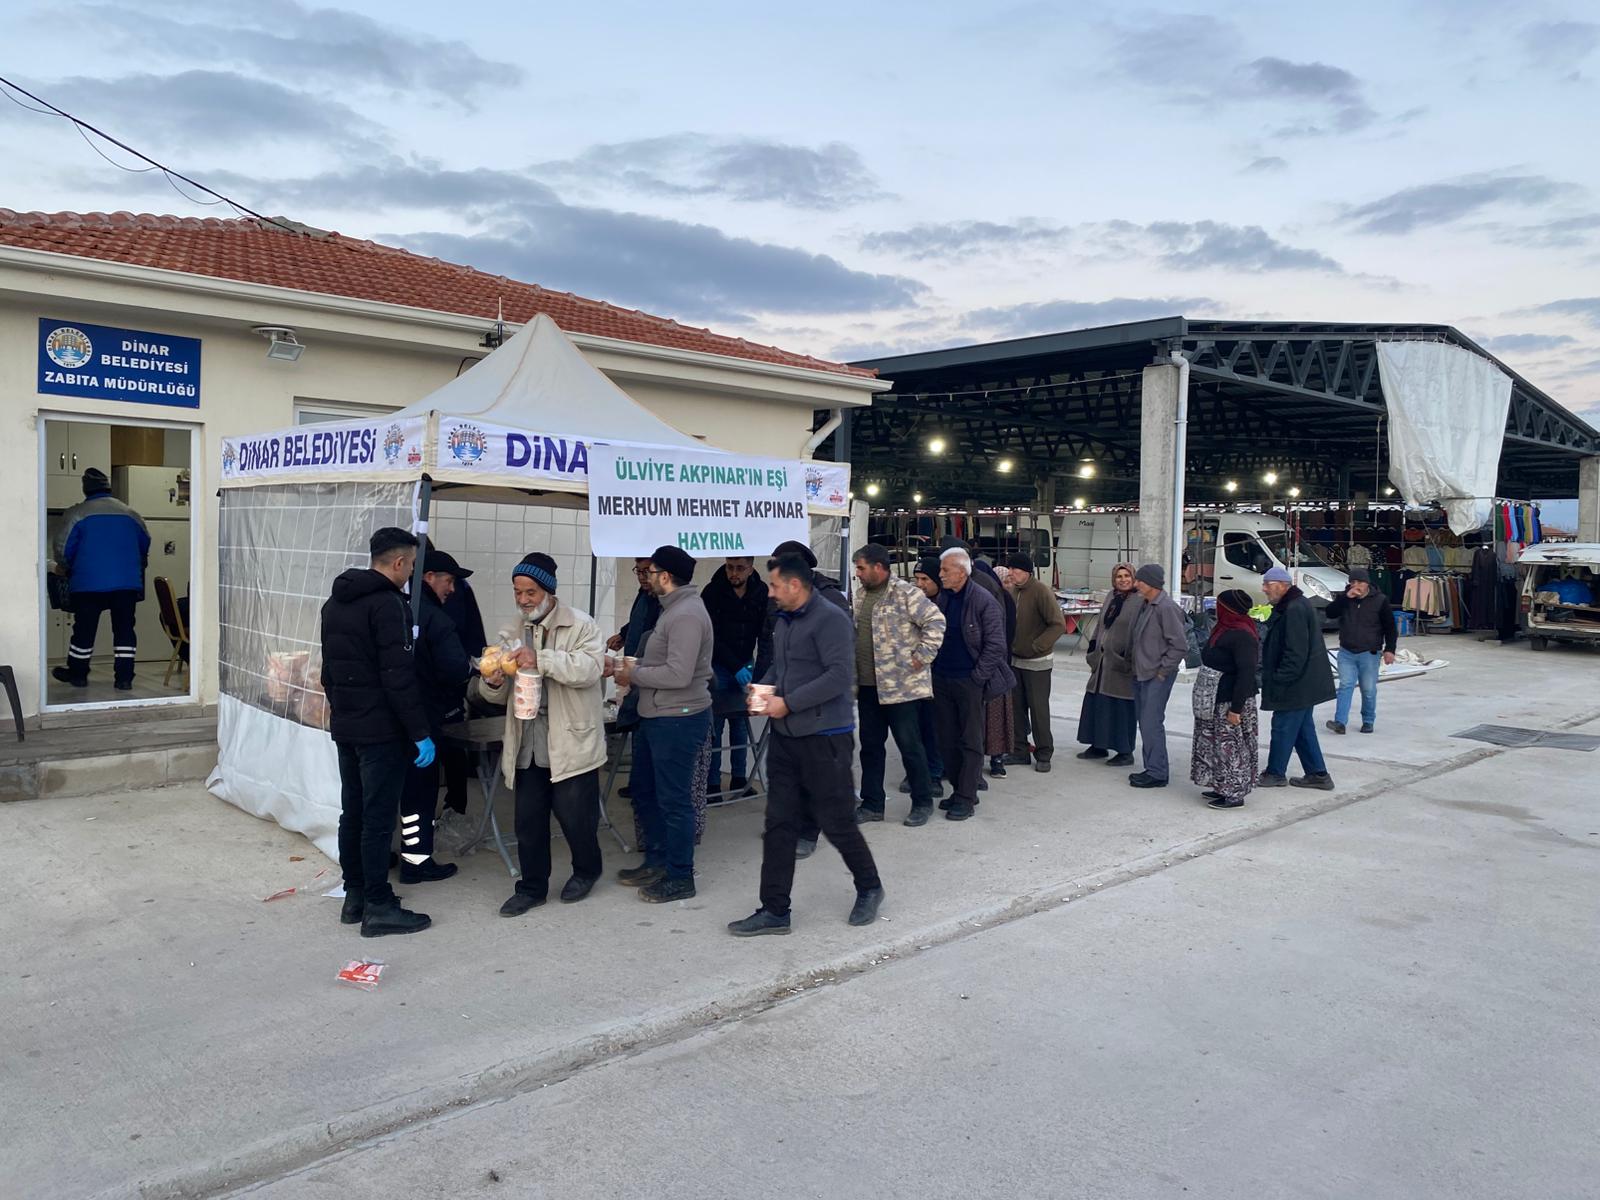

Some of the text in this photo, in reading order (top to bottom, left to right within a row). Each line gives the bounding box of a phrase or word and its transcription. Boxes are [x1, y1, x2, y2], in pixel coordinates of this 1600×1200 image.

[121, 340, 170, 356] DİNAR
[101, 354, 188, 374] BELEDİYESİ
[44, 371, 196, 397] ZABITA MÜDÜRLÜĞÜ
[616, 456, 675, 481] ÜLVİYE
[679, 464, 763, 486] AKPINAR'IN
[767, 467, 788, 491] EŞİ
[598, 496, 804, 519] MERHUM MEHMET AKPINAR
[678, 532, 744, 550] HAYRINA
